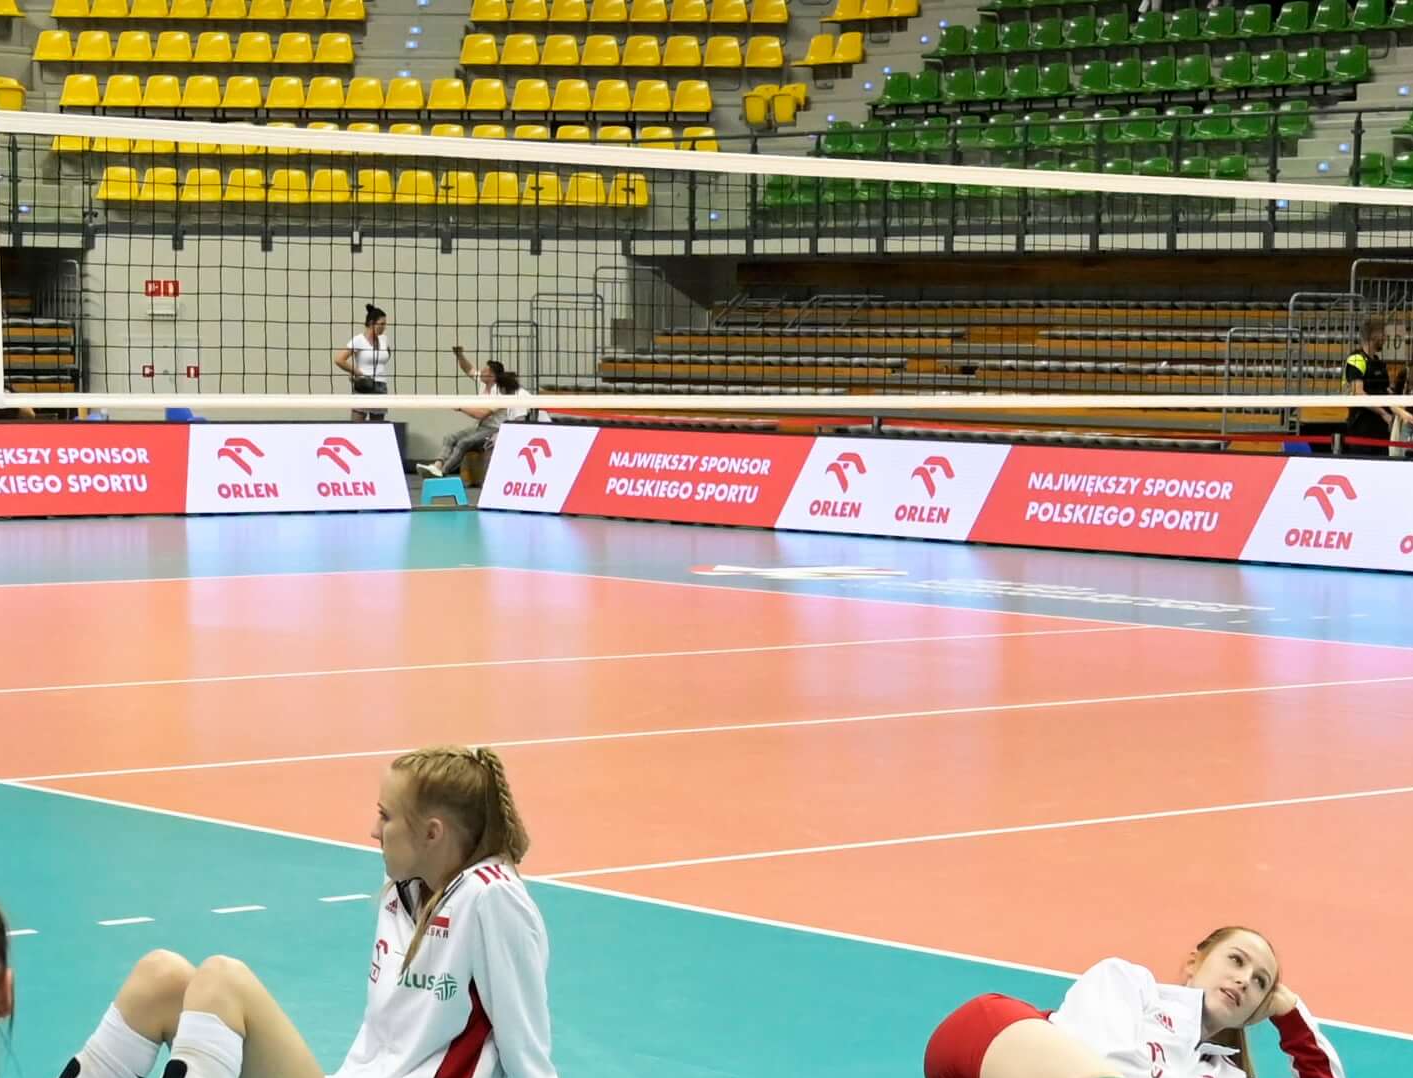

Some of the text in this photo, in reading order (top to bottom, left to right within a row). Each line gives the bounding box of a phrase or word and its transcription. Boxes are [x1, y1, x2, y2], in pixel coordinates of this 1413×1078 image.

[57, 447, 150, 465] SPONSOR
[608, 451, 771, 476] NAJWIĘKSZY SPONSOR
[67, 474, 148, 493] SPORTU
[217, 482, 279, 499] ORLEN
[316, 481, 377, 498] ORLEN
[502, 480, 547, 498] ORLEN
[605, 477, 759, 503] POLSKIEGO SPORTU
[1027, 472, 1234, 500] NAJWIĘKSZY SPONSOR
[809, 499, 862, 518] ORLEN
[894, 504, 950, 524] ORLEN
[1024, 501, 1220, 532] POLSKIEGO SPORTU
[1284, 528, 1353, 550] ORLEN
[398, 967, 436, 990] lus
